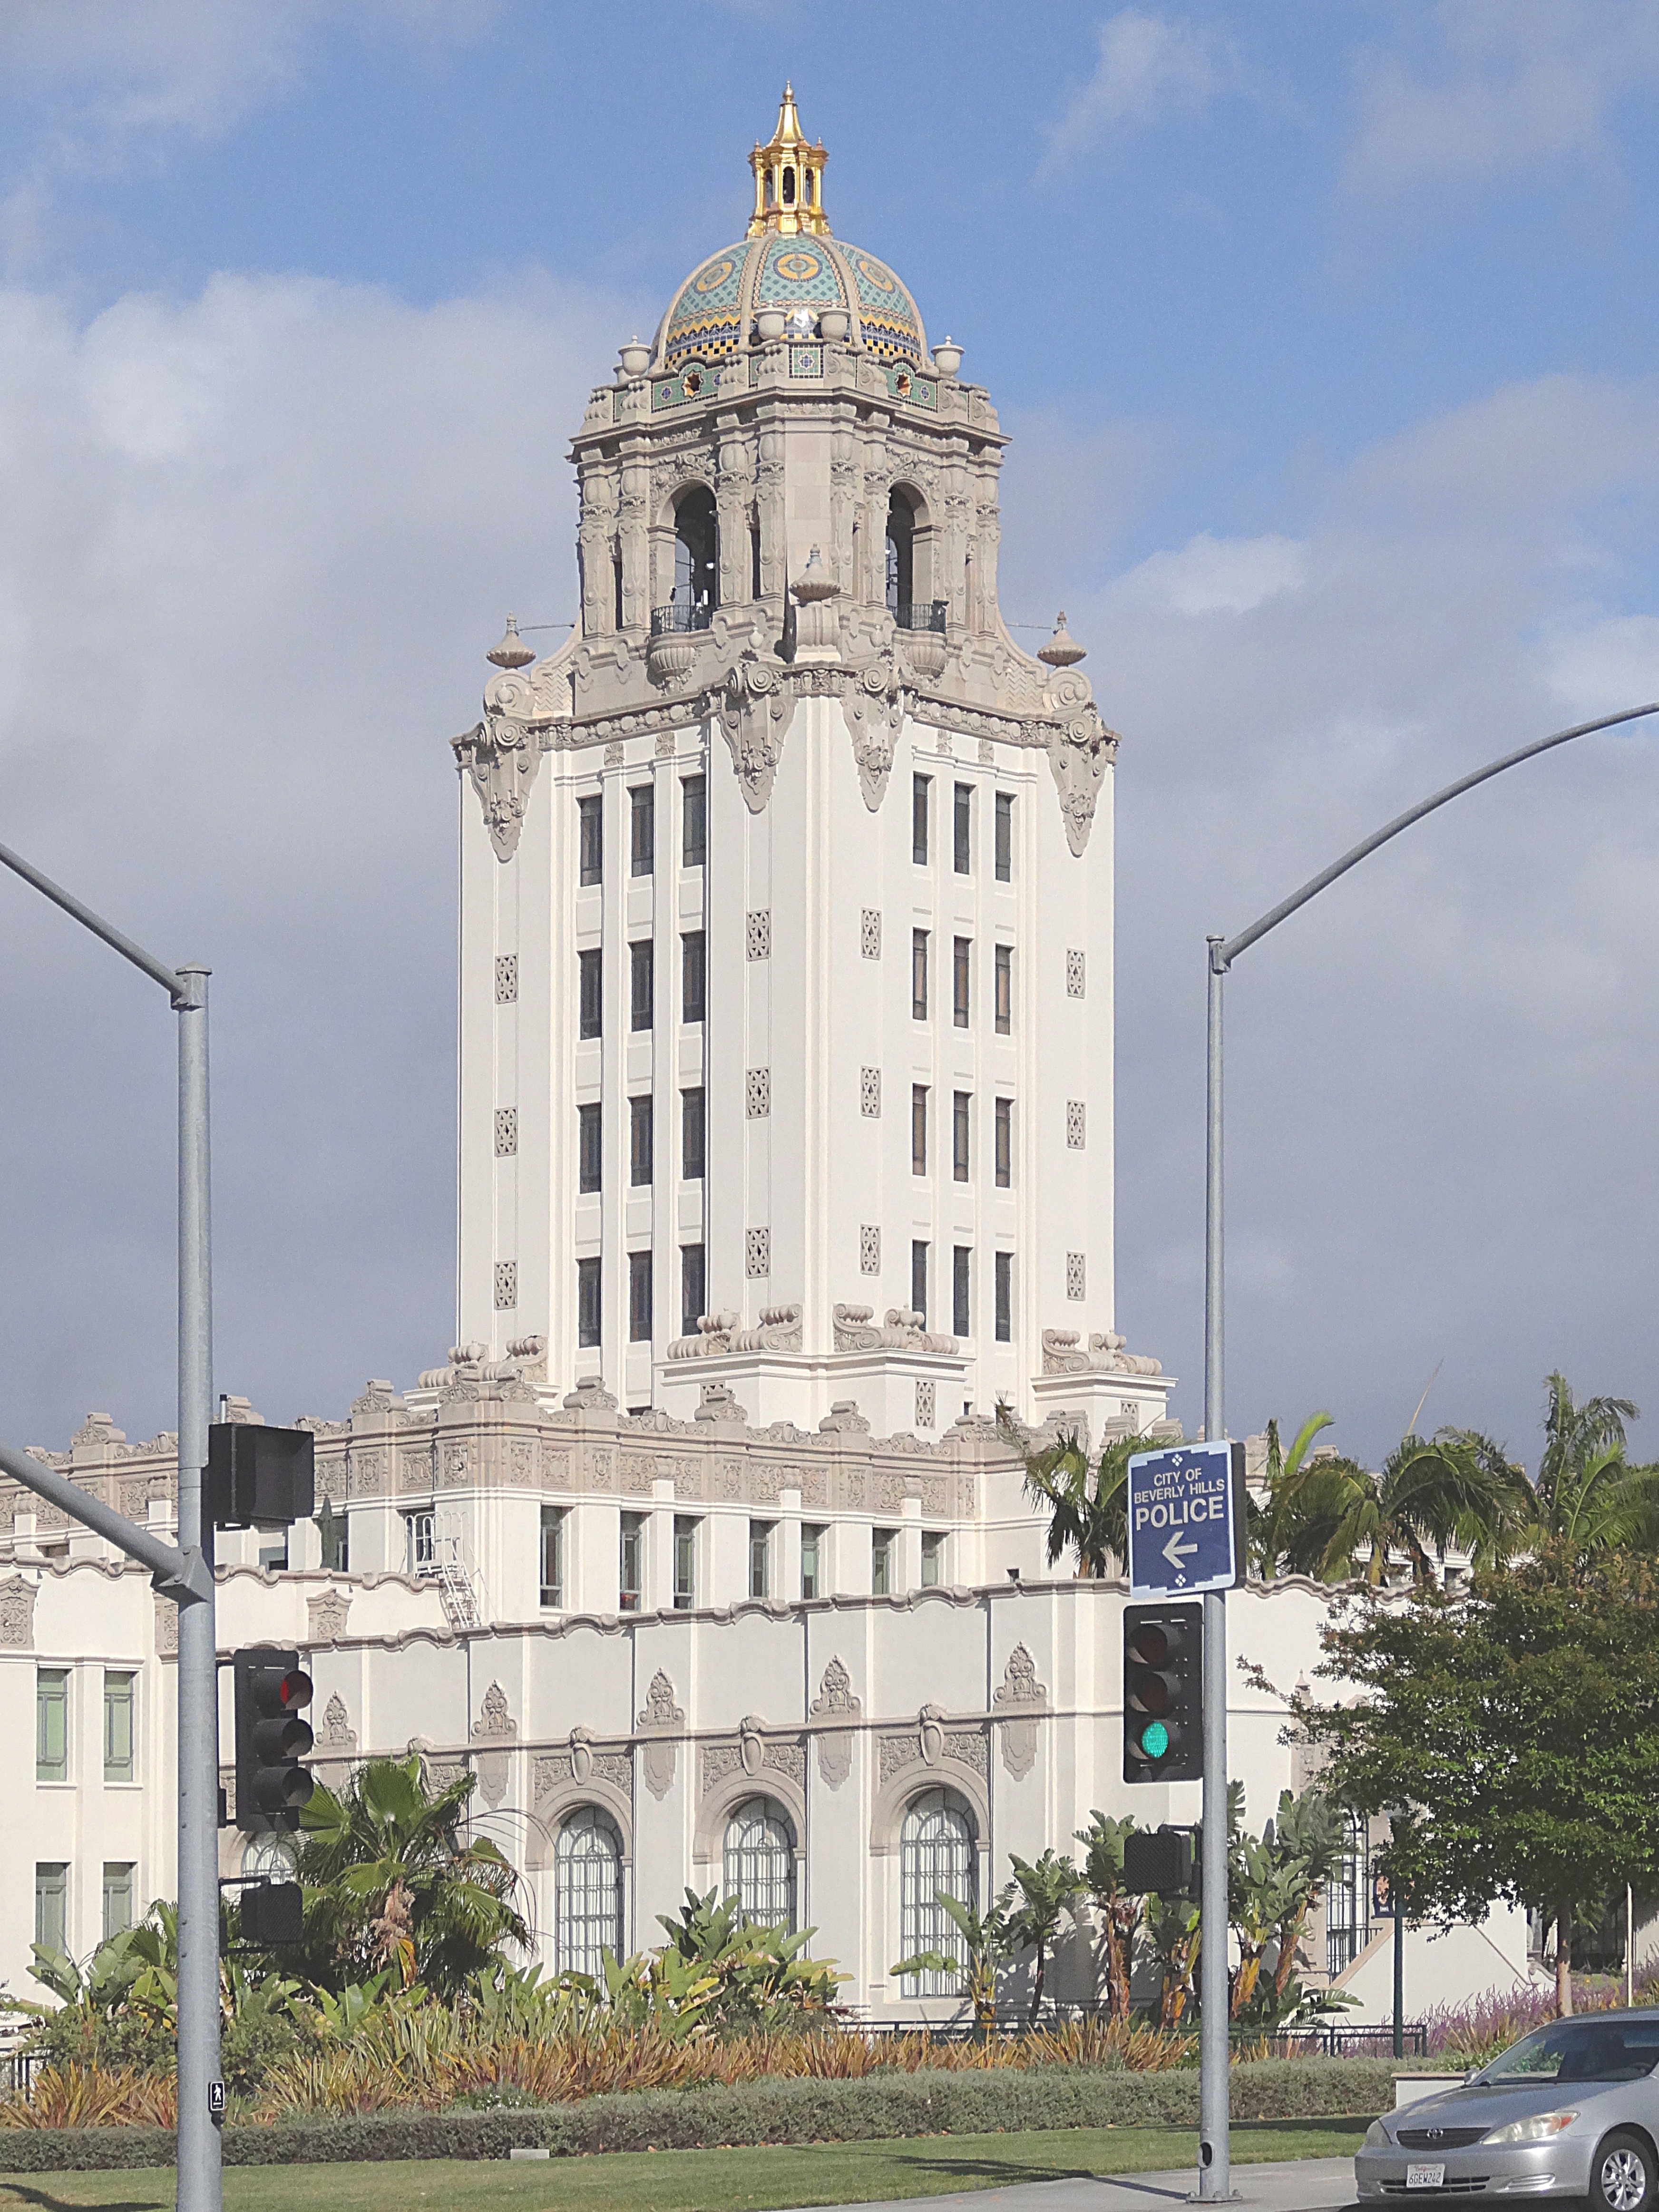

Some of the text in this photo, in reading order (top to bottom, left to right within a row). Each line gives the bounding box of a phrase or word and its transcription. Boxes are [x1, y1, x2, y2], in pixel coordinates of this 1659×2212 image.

[1154, 1468, 1202, 1487] CITY OF
[1134, 1479, 1225, 1504] BEVERLY HILLS
[1136, 1496, 1224, 1531] POLICE
[1409, 2172, 1441, 2184] 6GEW242
